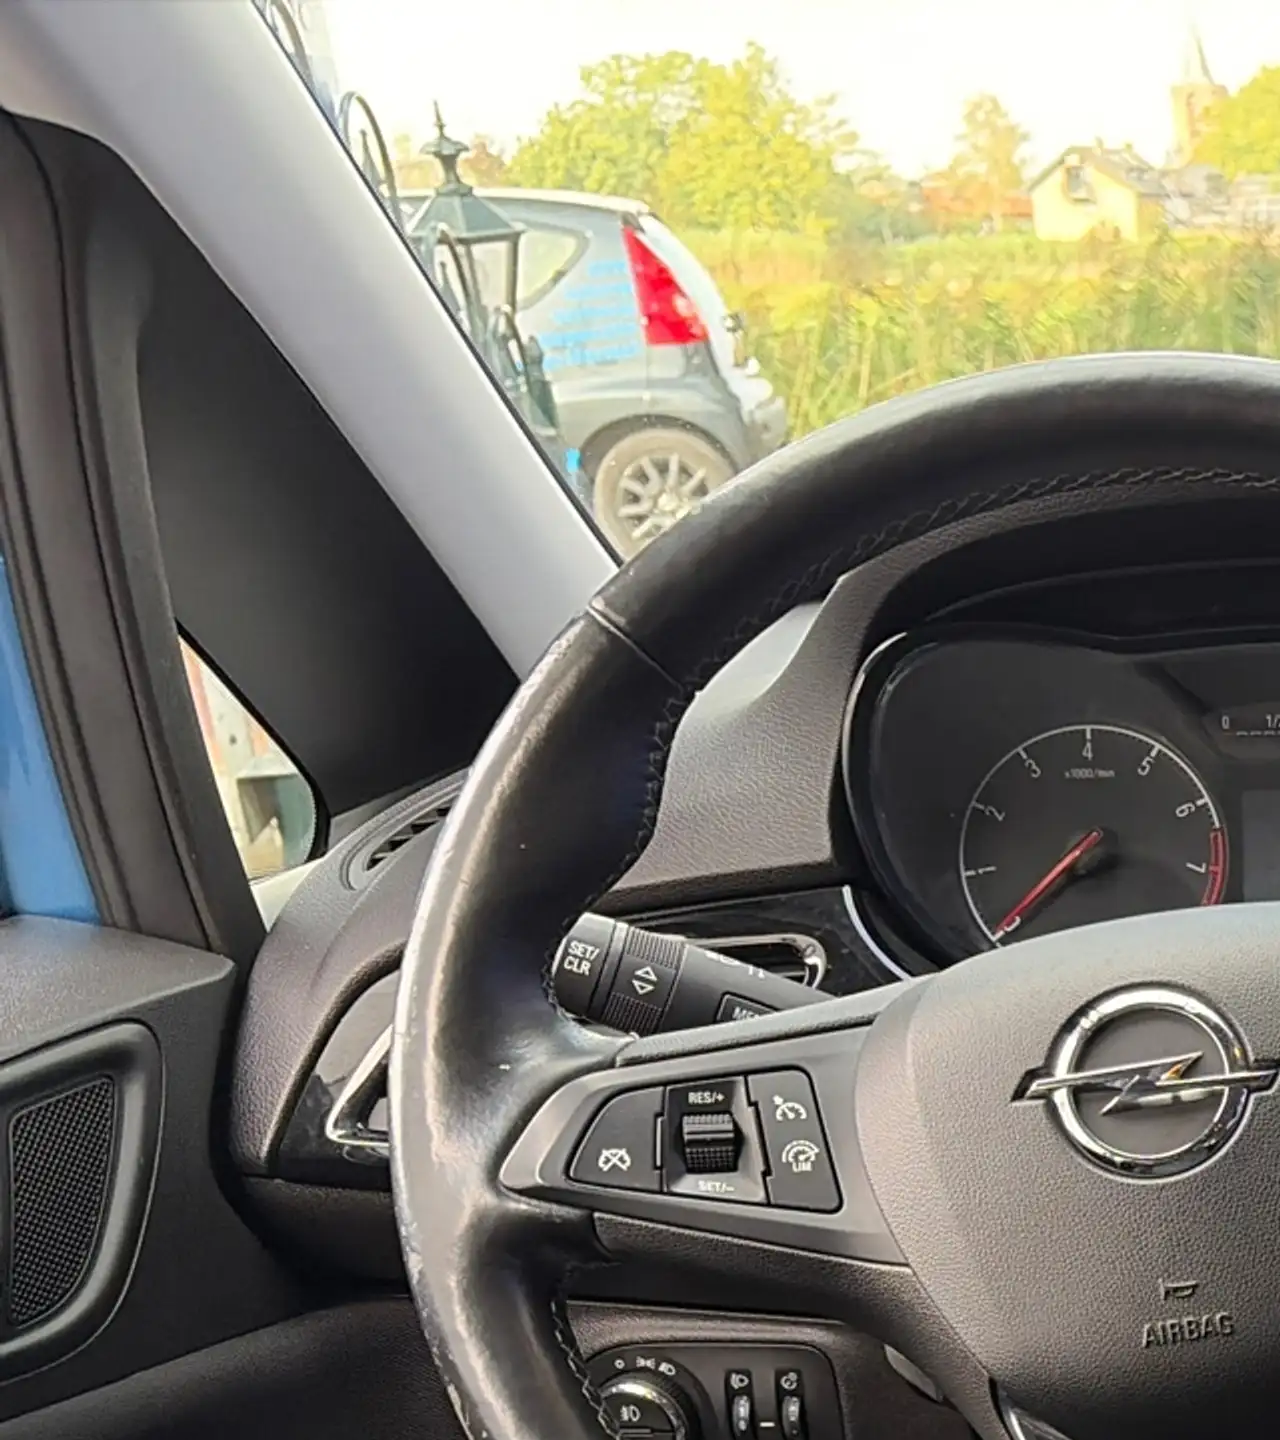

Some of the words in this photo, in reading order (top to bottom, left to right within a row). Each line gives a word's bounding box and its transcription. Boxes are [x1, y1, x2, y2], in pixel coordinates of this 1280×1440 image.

[1082, 742, 1093, 761] 4
[1024, 759, 1042, 778] 3
[1137, 759, 1155, 776] 5
[985, 805, 1006, 822] 2
[1175, 802, 1196, 818] 6
[978, 866, 997, 875] 1
[1186, 862, 1206, 874] 7
[568, 939, 600, 961] SET/
[563, 955, 591, 977] CLR
[1142, 1311, 1236, 1349] AIRBAG
